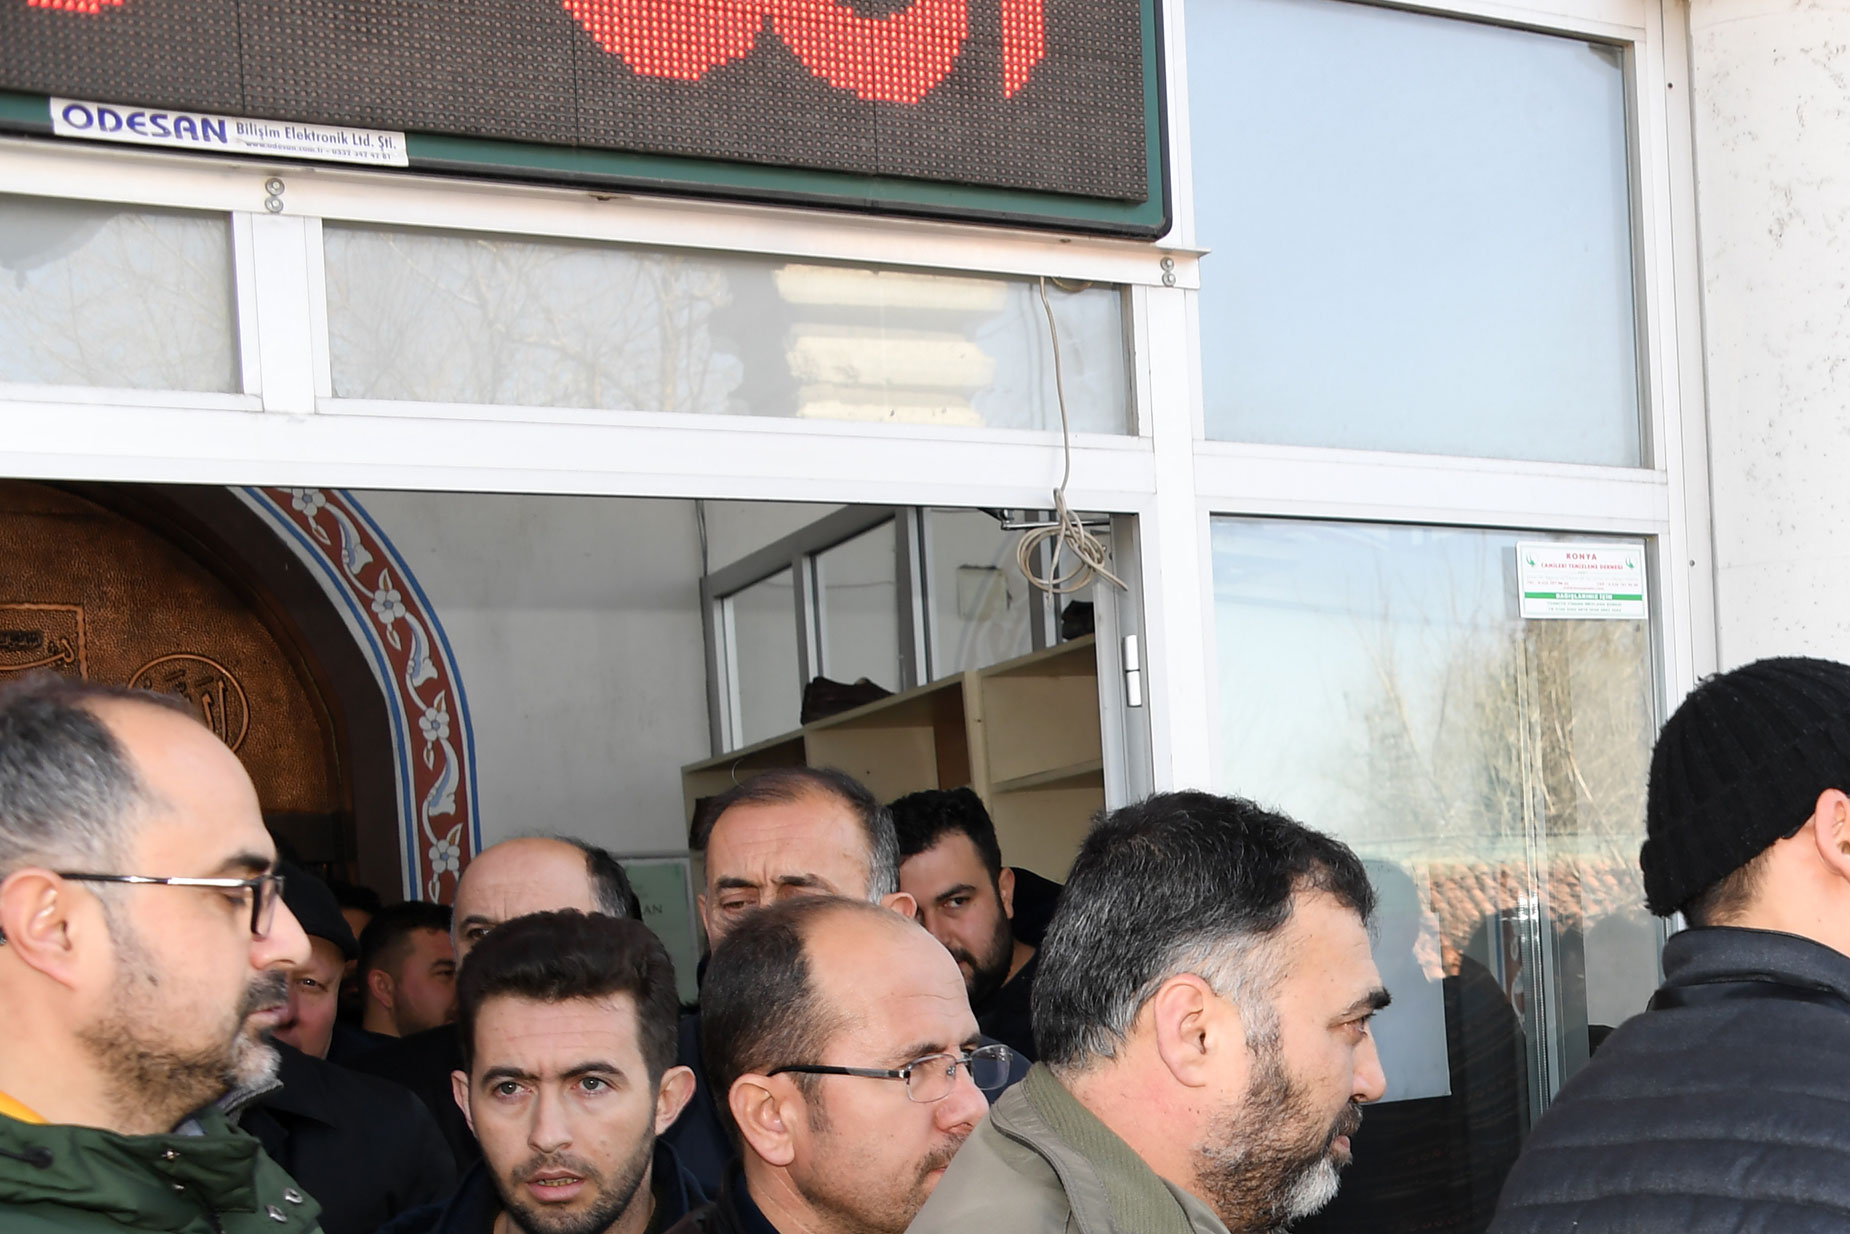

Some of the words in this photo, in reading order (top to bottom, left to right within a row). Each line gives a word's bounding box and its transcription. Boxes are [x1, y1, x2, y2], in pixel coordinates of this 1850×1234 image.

[62, 103, 228, 143] ODESAN
[236, 122, 280, 140] Bilişim
[285, 126, 348, 145] Elektronik
[352, 133, 374, 147] Ltd.
[378, 135, 397, 151] Şti.
[1566, 552, 1597, 560] KONYA
